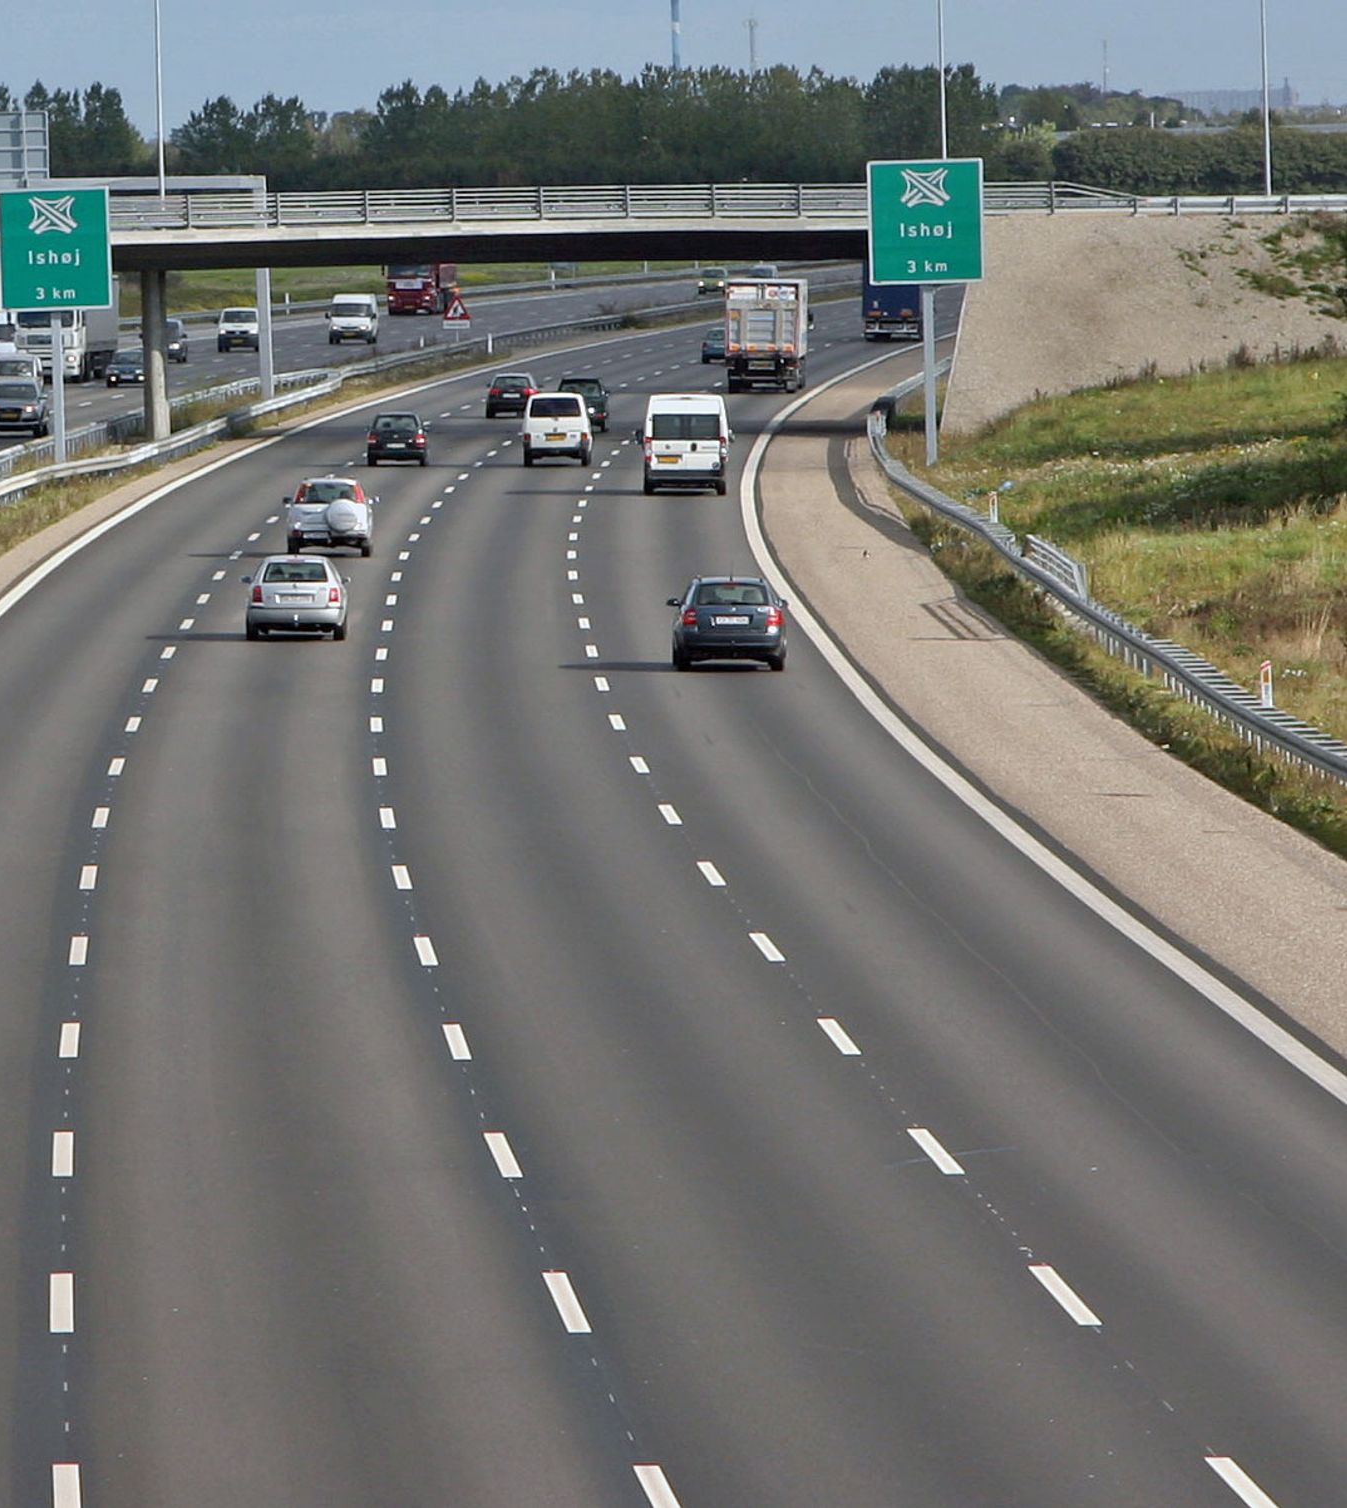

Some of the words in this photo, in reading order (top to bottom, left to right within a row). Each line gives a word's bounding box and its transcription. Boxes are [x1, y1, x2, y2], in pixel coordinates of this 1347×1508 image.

[900, 221, 952, 239] Ishøj
[28, 248, 80, 266] Ishøj
[907, 260, 916, 273] 3
[924, 260, 947, 272] km
[35, 287, 45, 300] 3
[53, 287, 76, 299] km
